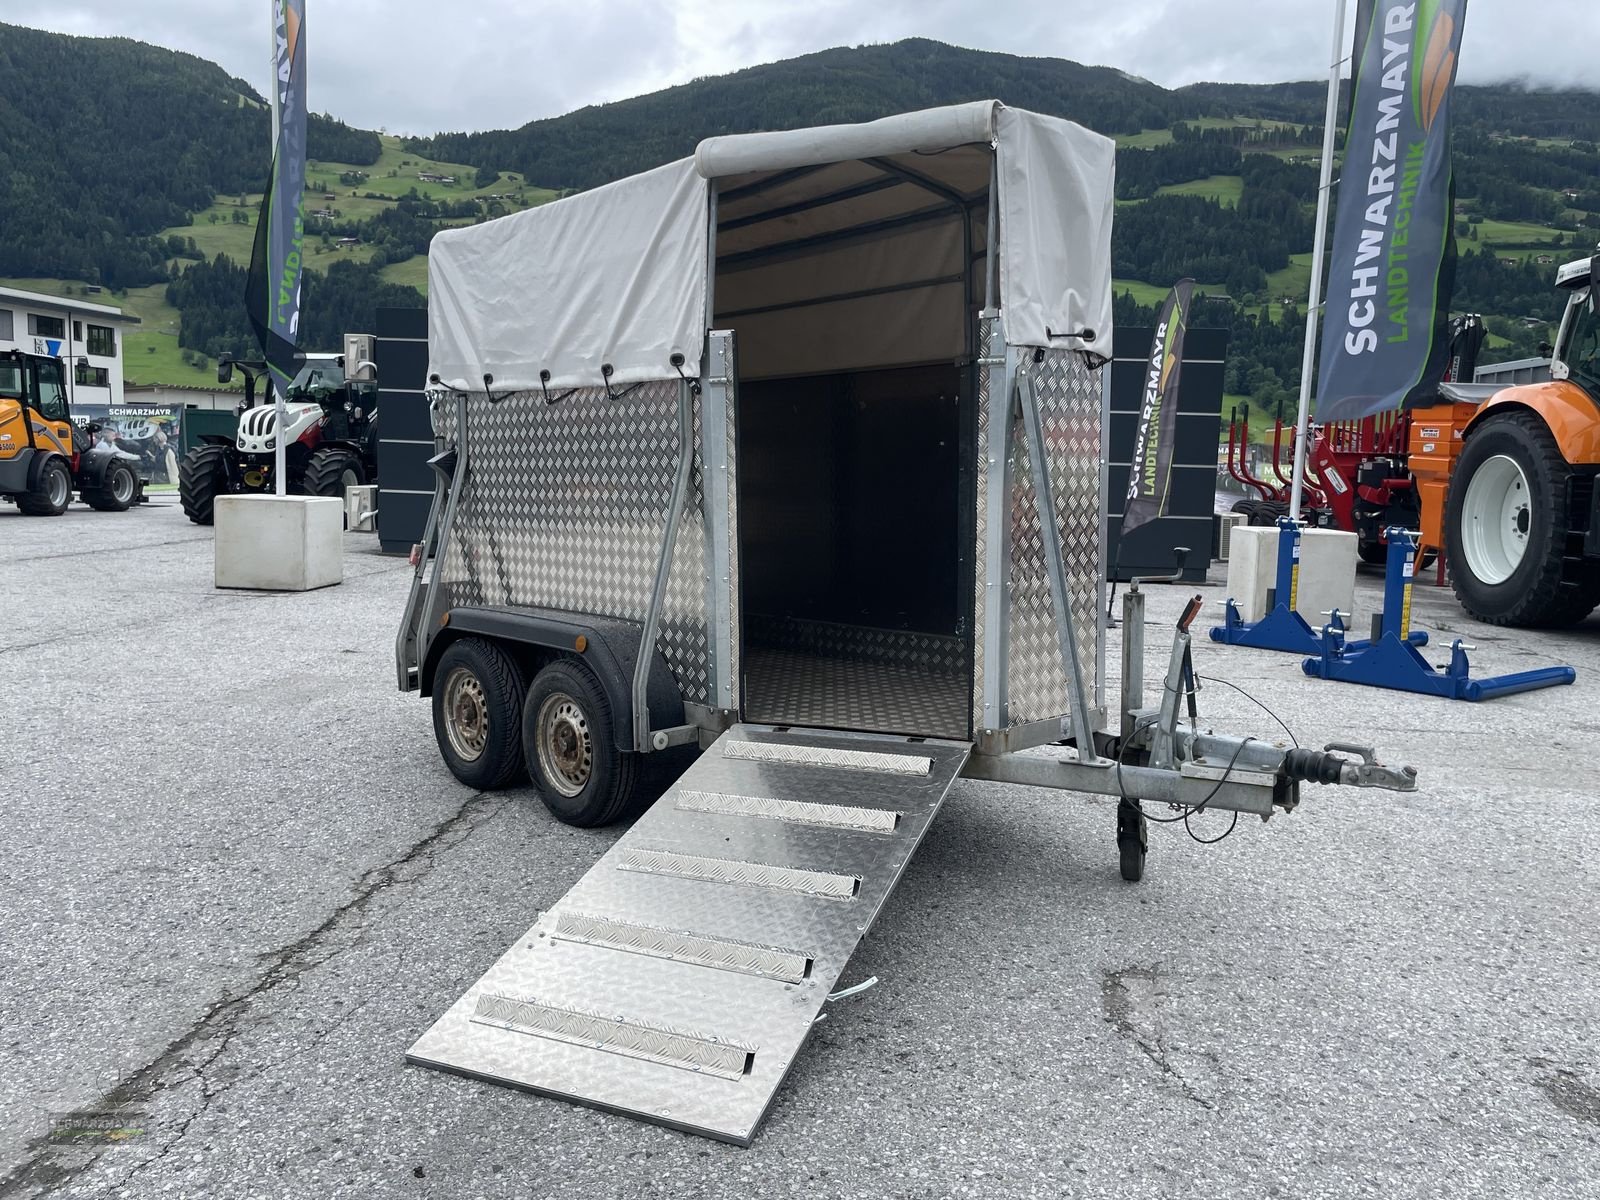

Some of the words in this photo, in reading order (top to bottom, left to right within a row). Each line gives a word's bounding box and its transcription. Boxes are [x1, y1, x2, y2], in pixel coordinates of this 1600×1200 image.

[1344, 1, 1416, 356] SCHWARZMAYR
[1386, 139, 1427, 344] LANDTECHNIK
[108, 408, 172, 416] SCHWARZMAYR
